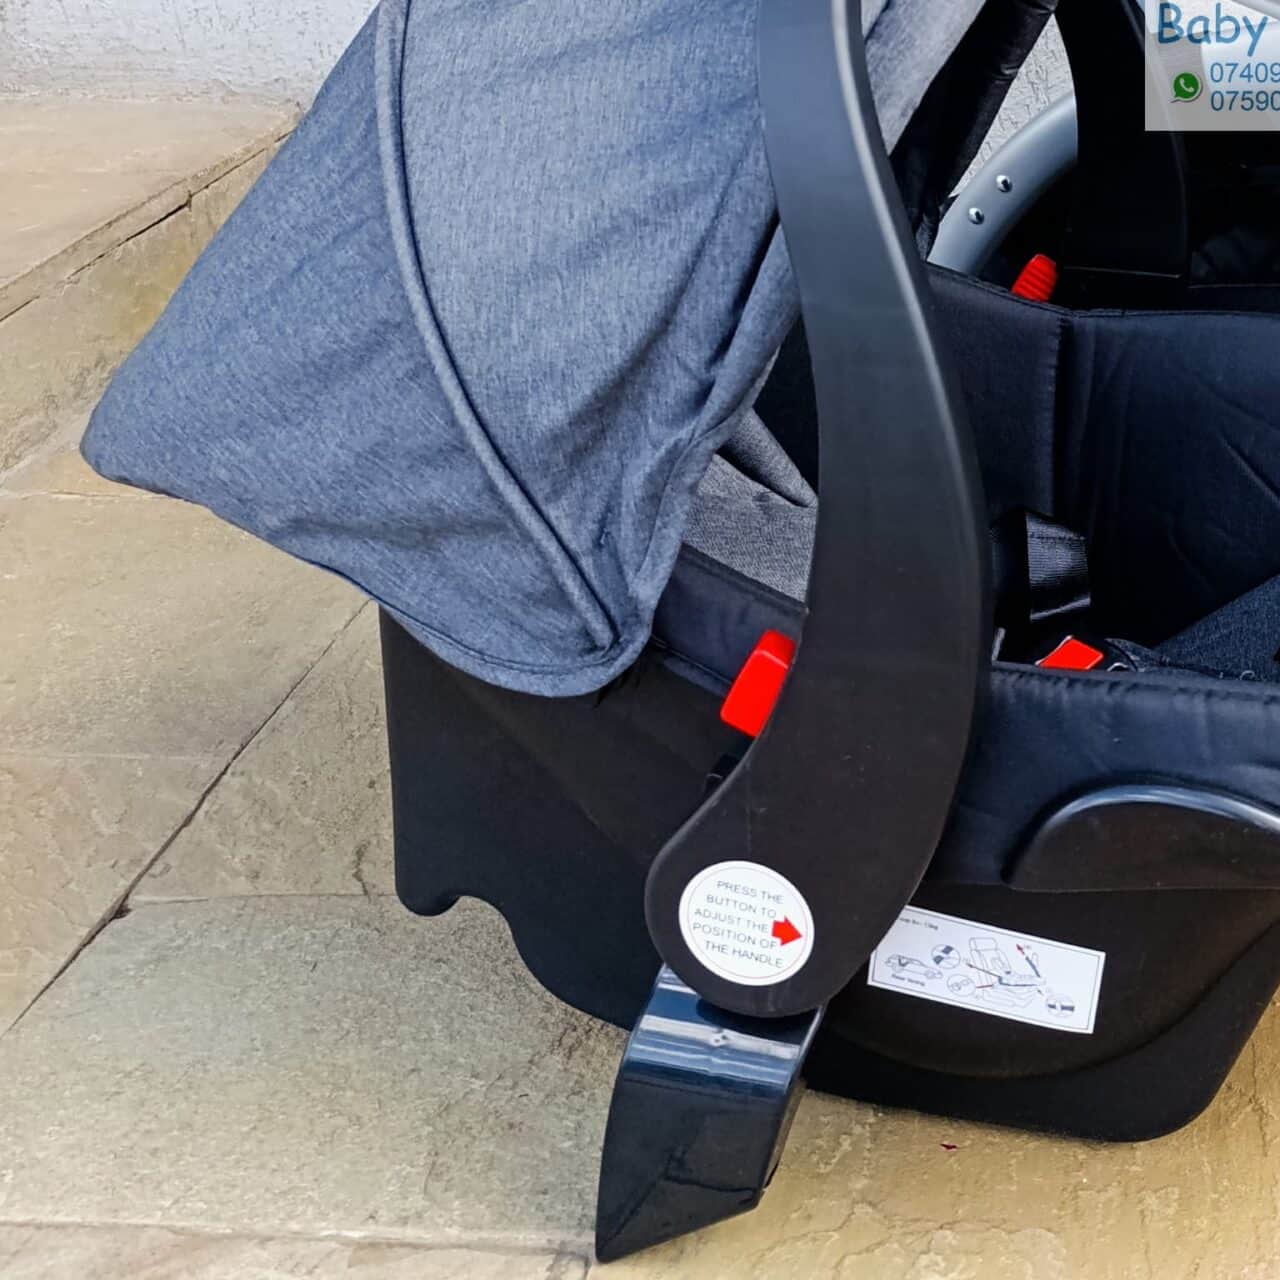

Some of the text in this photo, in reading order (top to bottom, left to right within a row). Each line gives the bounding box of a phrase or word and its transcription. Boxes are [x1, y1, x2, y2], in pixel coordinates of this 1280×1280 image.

[716, 880, 784, 905] PRESS THE
[706, 894, 777, 919] BUTTON TO
[694, 908, 769, 933] ADJUST THE
[693, 922, 778, 950] POSITION OF
[705, 940, 783, 968] THE HANDLE
